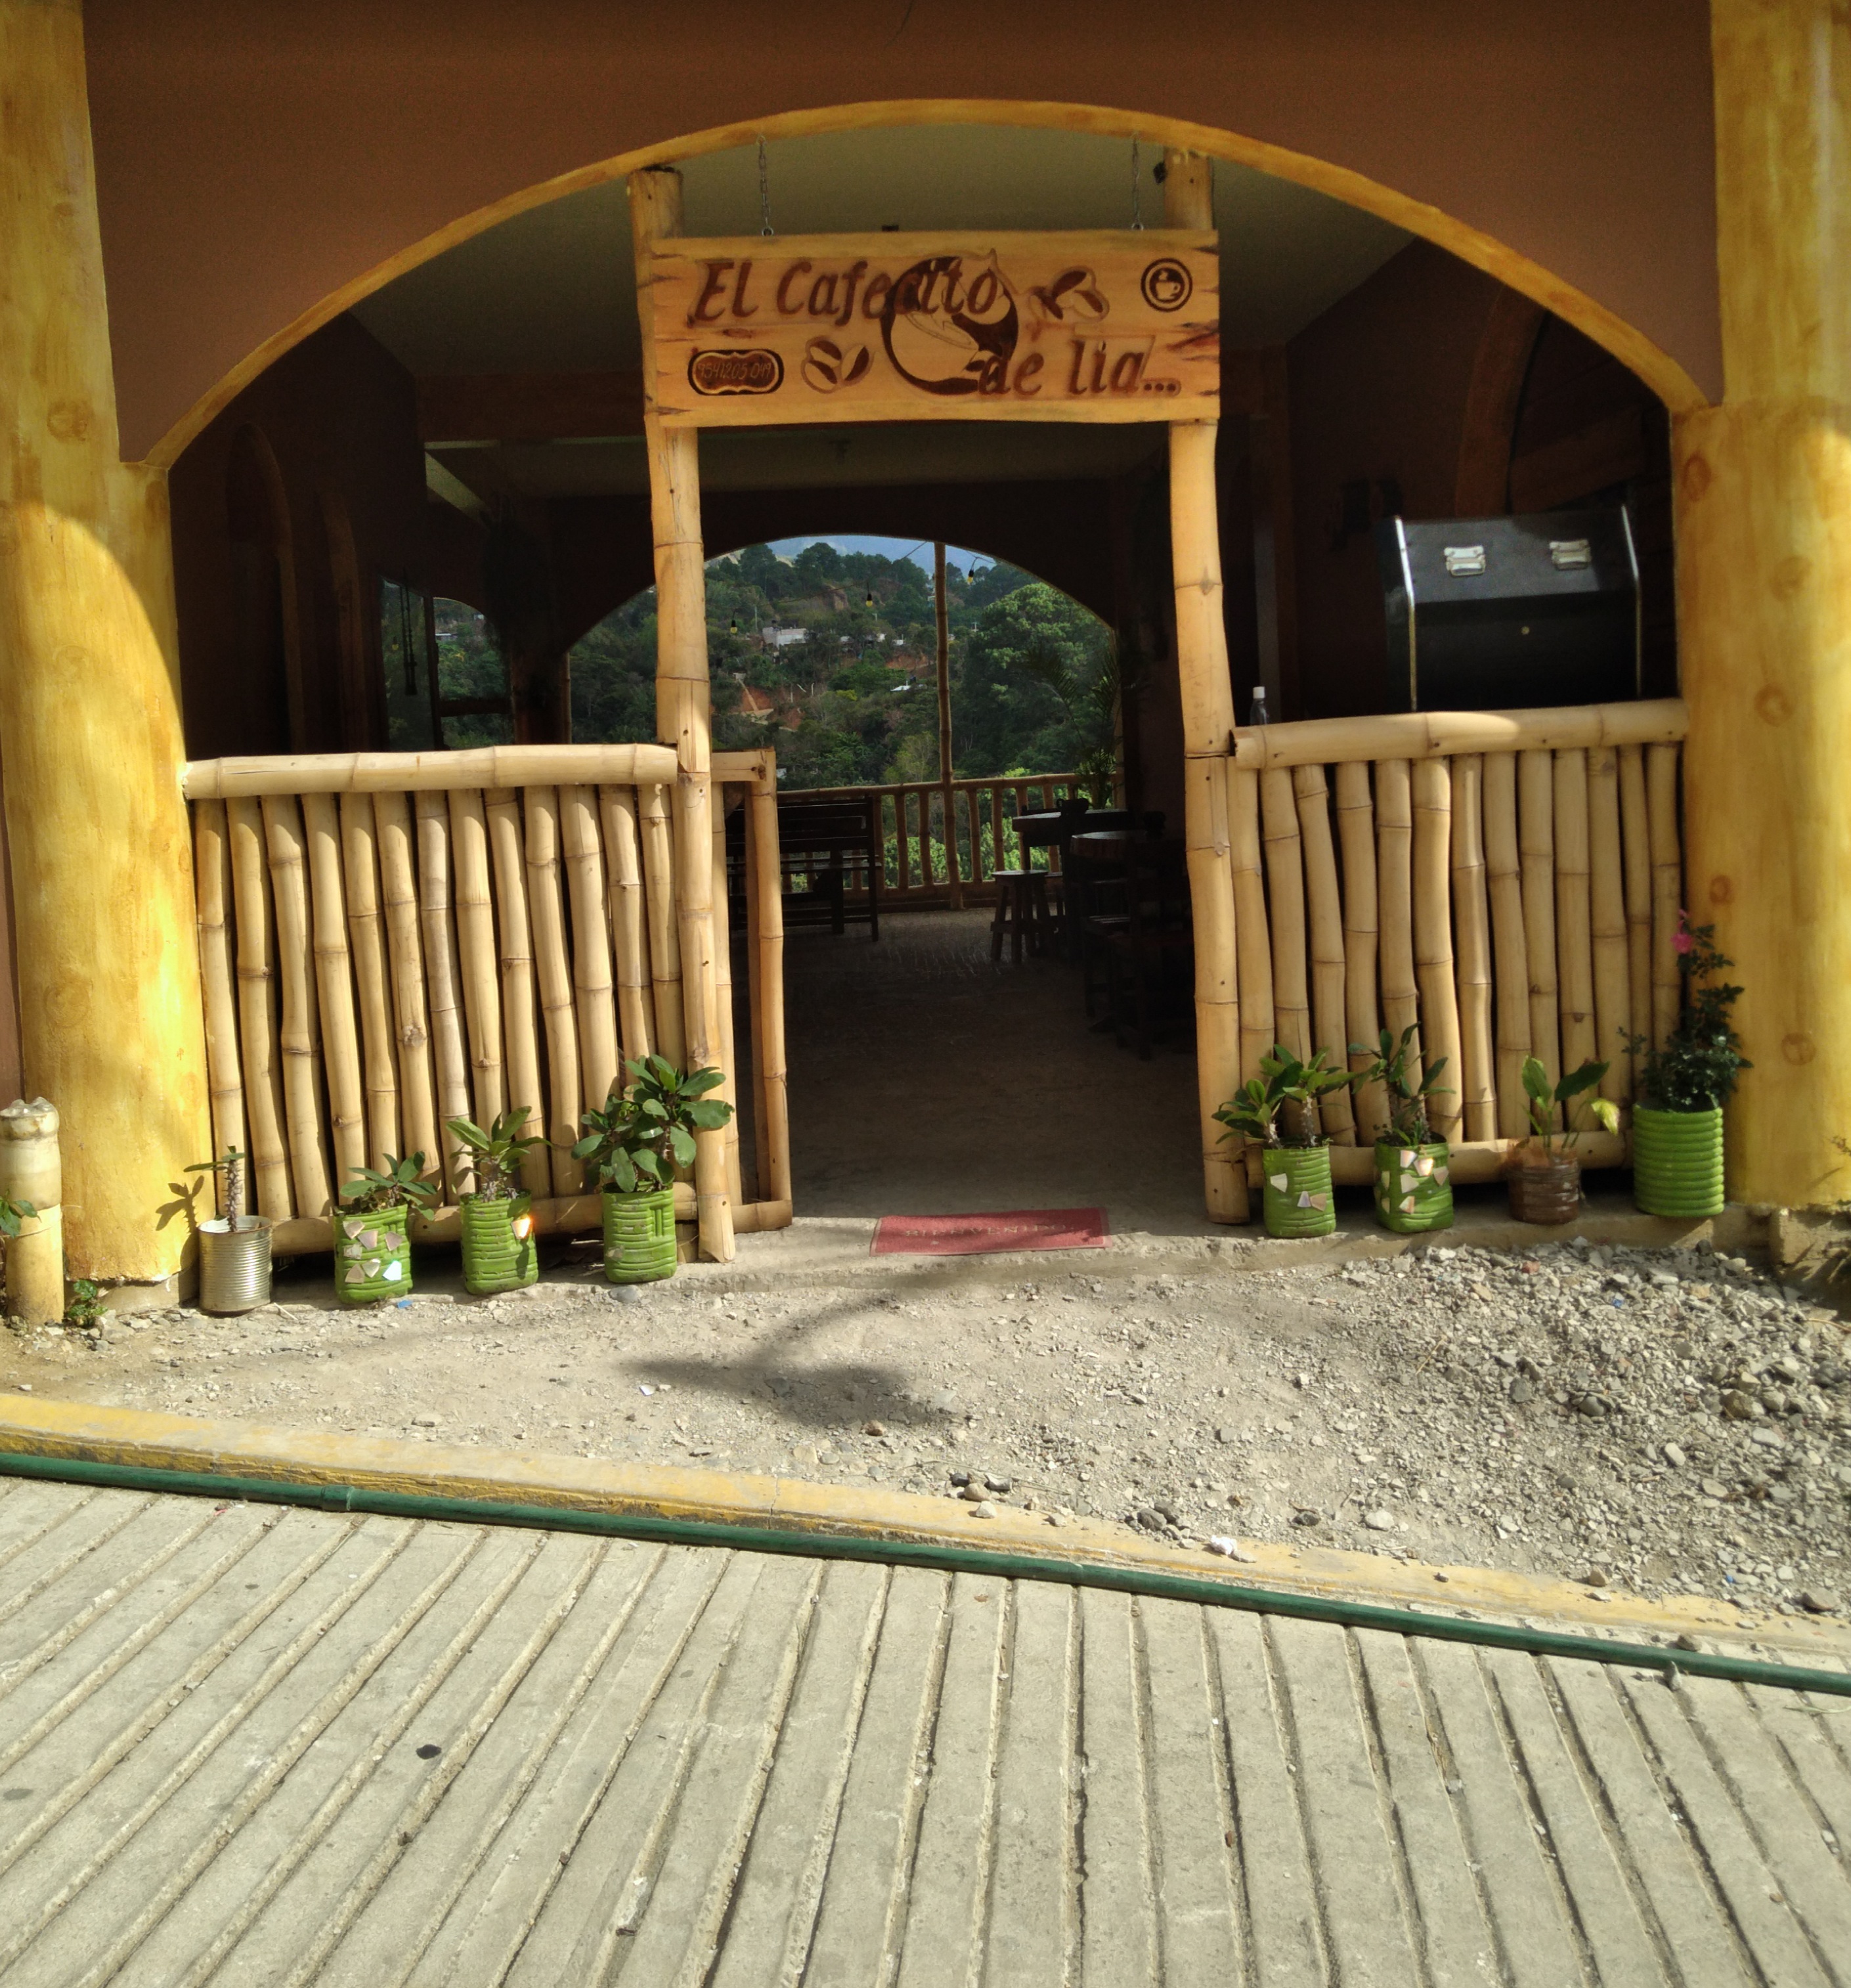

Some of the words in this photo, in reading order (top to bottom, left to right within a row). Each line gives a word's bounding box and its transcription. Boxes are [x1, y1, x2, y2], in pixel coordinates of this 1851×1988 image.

[693, 257, 759, 321] El
[776, 255, 998, 327] Cafecito
[978, 338, 1045, 395] de
